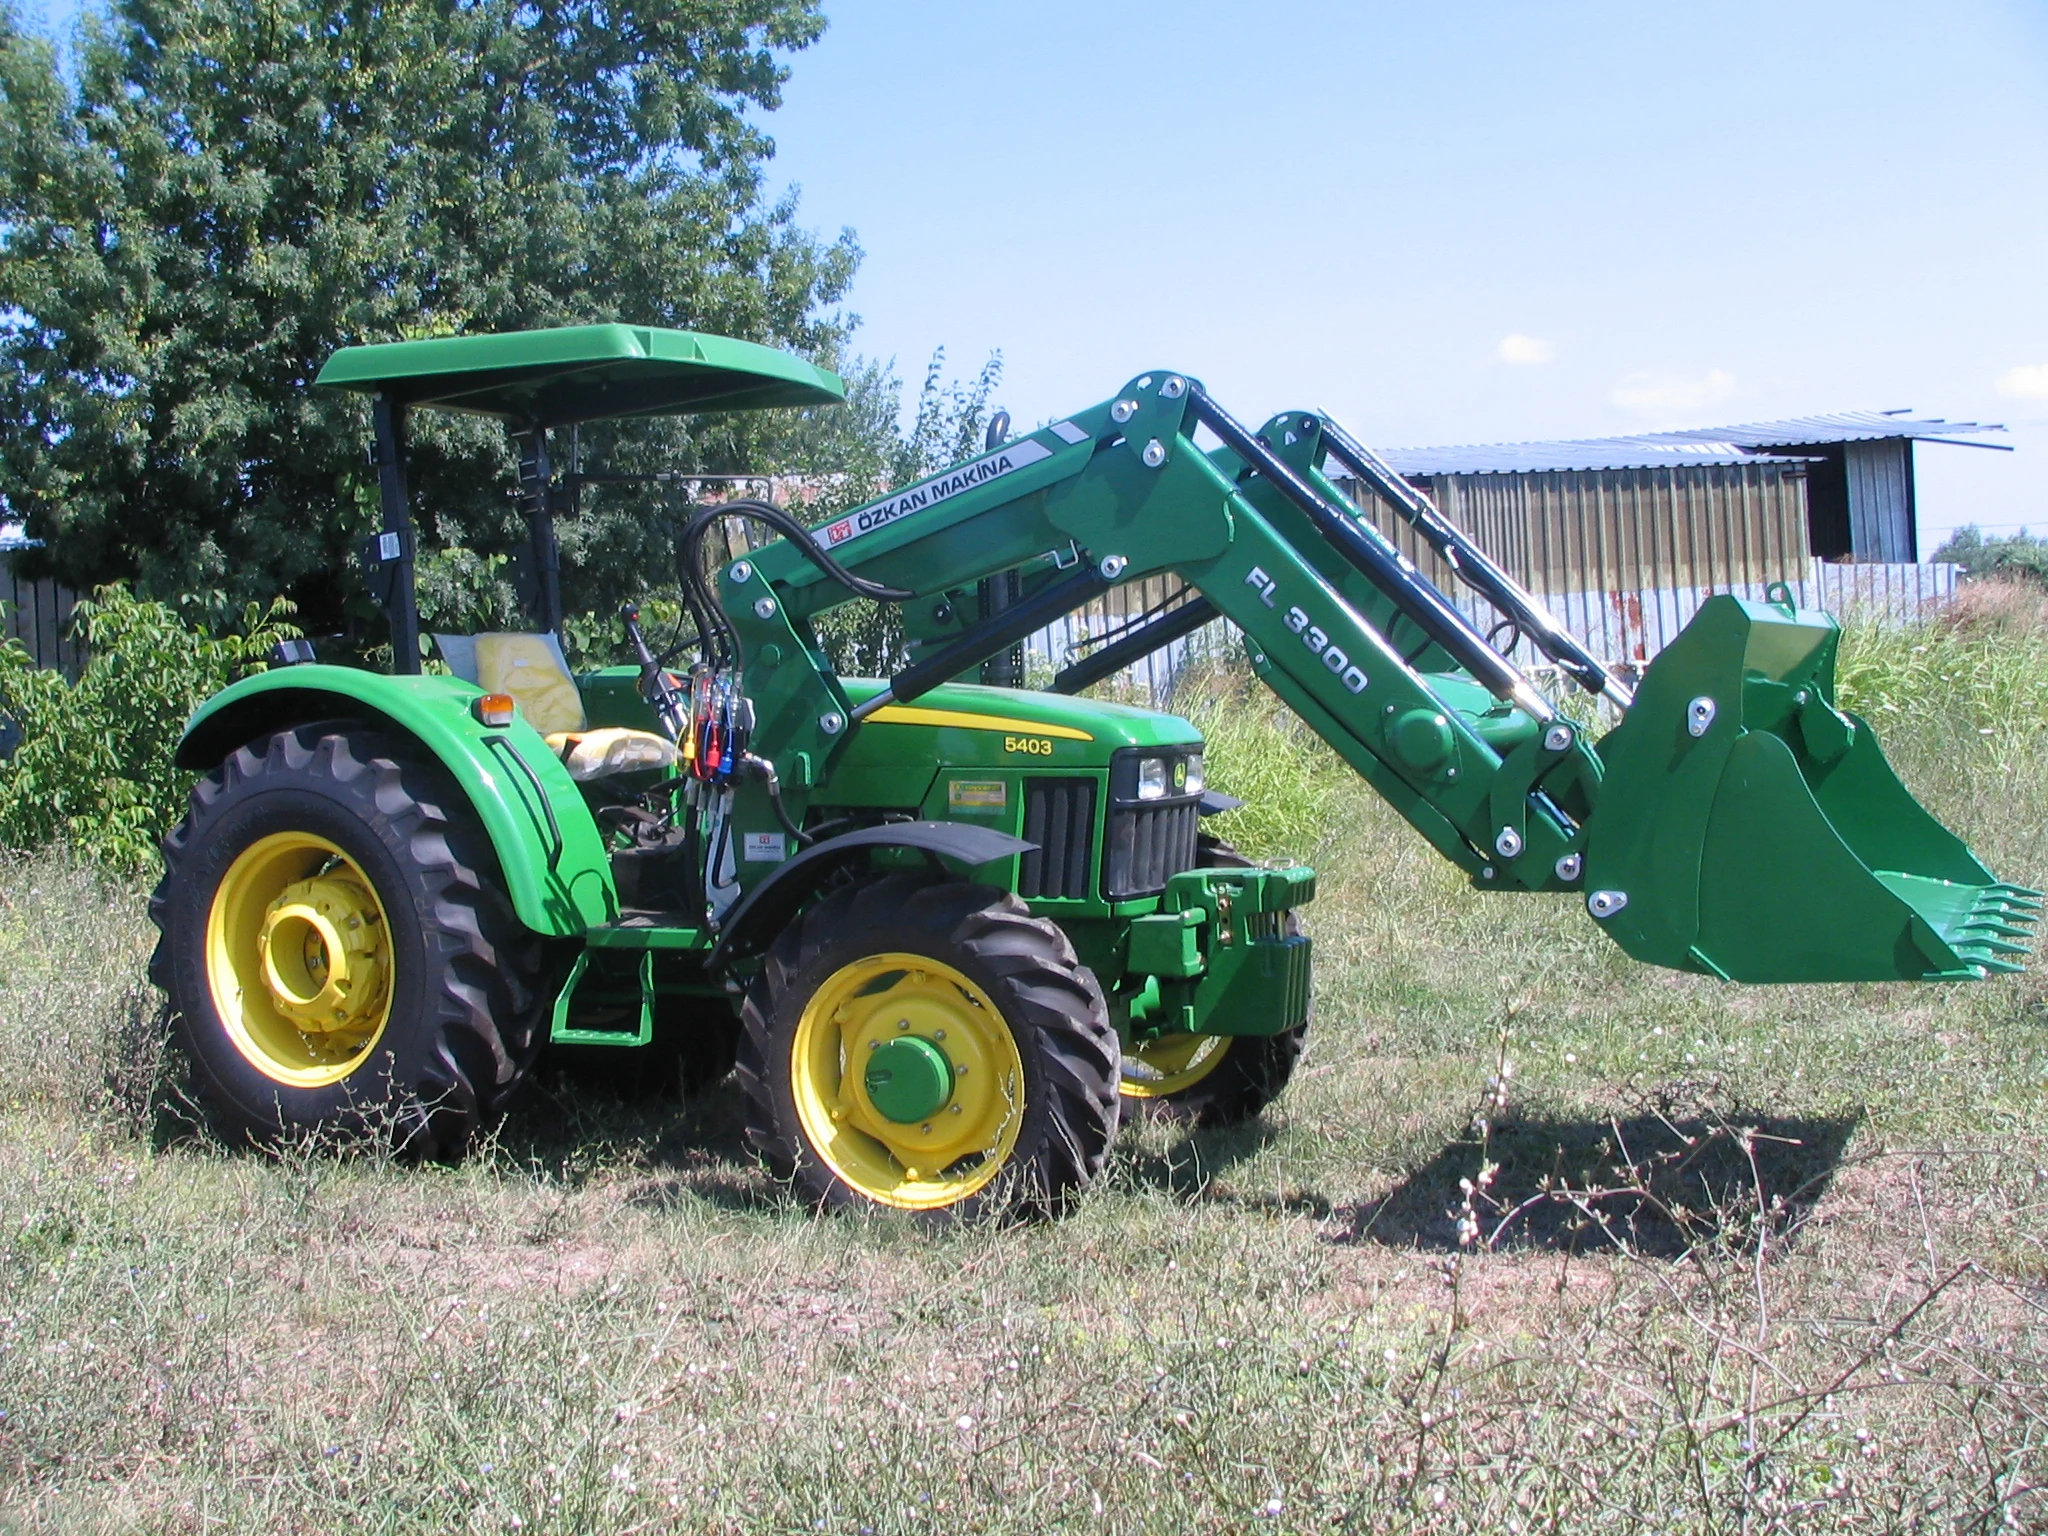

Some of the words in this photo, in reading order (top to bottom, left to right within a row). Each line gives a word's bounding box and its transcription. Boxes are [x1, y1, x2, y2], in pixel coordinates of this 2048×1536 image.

[858, 491, 927, 531] ÖZKAN
[931, 456, 1014, 499] MAKİNA
[1243, 566, 1276, 609] FL
[1282, 606, 1369, 695] 3300
[1004, 736, 1052, 756] 5403
